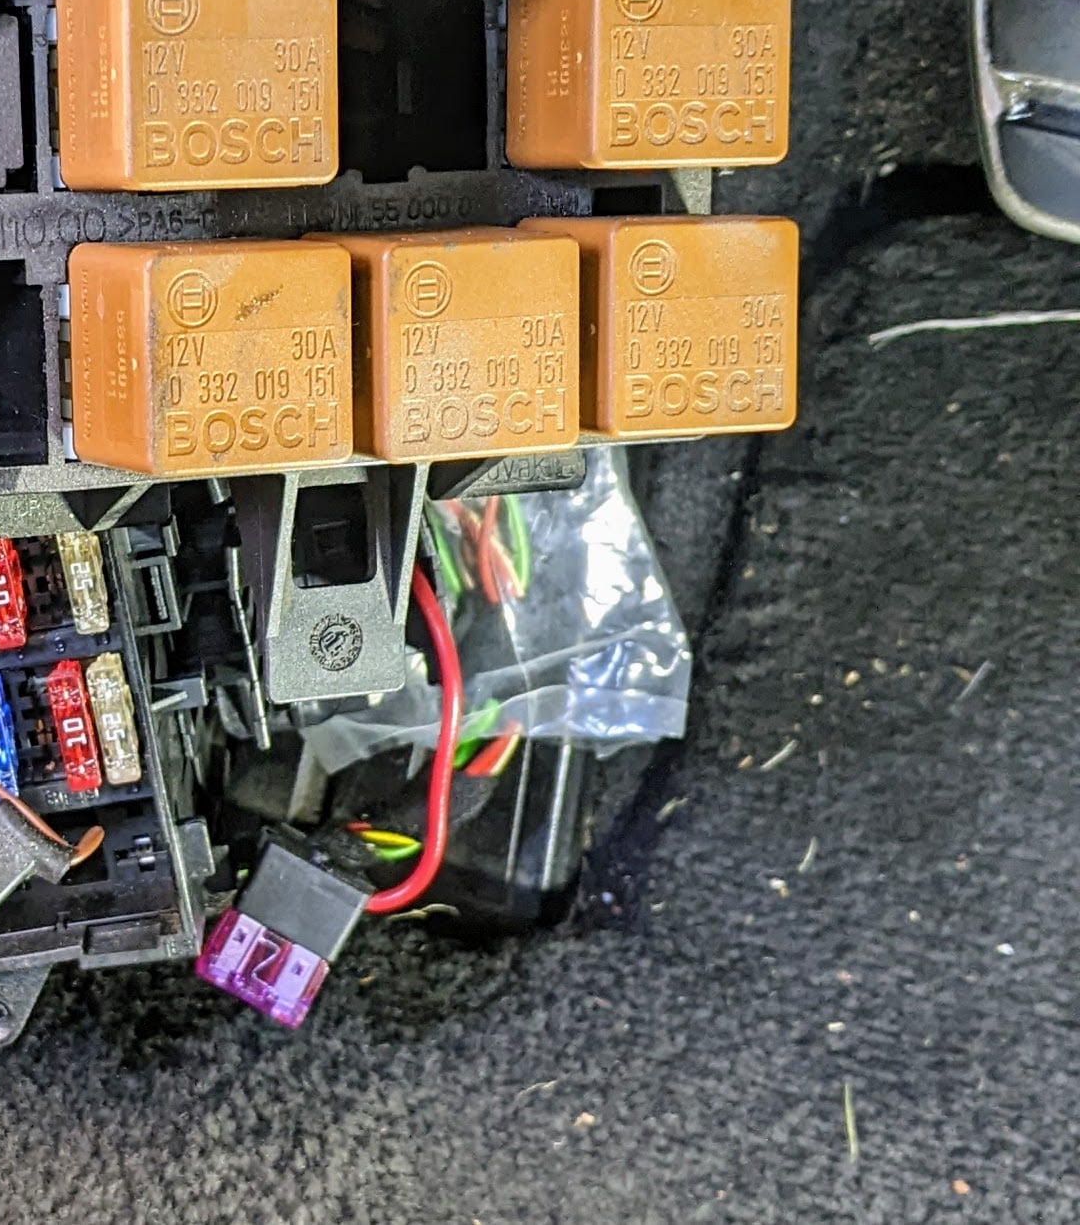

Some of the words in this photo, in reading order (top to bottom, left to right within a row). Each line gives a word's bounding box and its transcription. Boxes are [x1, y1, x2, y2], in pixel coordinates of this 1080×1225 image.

[144, 40, 185, 77] 12V
[274, 39, 321, 73] 30A
[613, 28, 651, 60] 12V
[732, 25, 775, 58] 30A
[177, 80, 219, 114] 332
[235, 79, 272, 113] 019
[288, 77, 321, 112] 151
[642, 65, 681, 97] 332
[696, 64, 729, 96] 019
[743, 63, 775, 95] 151
[144, 117, 323, 168] BOSCH
[610, 100, 776, 148] BOSCH
[628, 302, 664, 333] 12V
[742, 297, 783, 328] 30A
[167, 334, 205, 367] 12V
[291, 328, 336, 361] 30A
[402, 324, 439, 356] 12V
[521, 316, 565, 348] 30A
[655, 336, 692, 368] 332
[708, 335, 740, 366] 019
[753, 333, 782, 364] 151
[170, 374, 182, 406] 0
[198, 371, 238, 404] 332
[255, 367, 290, 400] 019
[304, 365, 336, 397] 151
[432, 359, 471, 391] 332
[486, 355, 520, 387] 019
[534, 352, 564, 384] 151
[626, 368, 784, 418] BOSCH
[166, 402, 338, 457] BOSCH
[402, 388, 566, 444] BOSCH
[70, 561, 93, 591] 25
[62, 717, 87, 748] 10
[101, 712, 126, 741] 25
